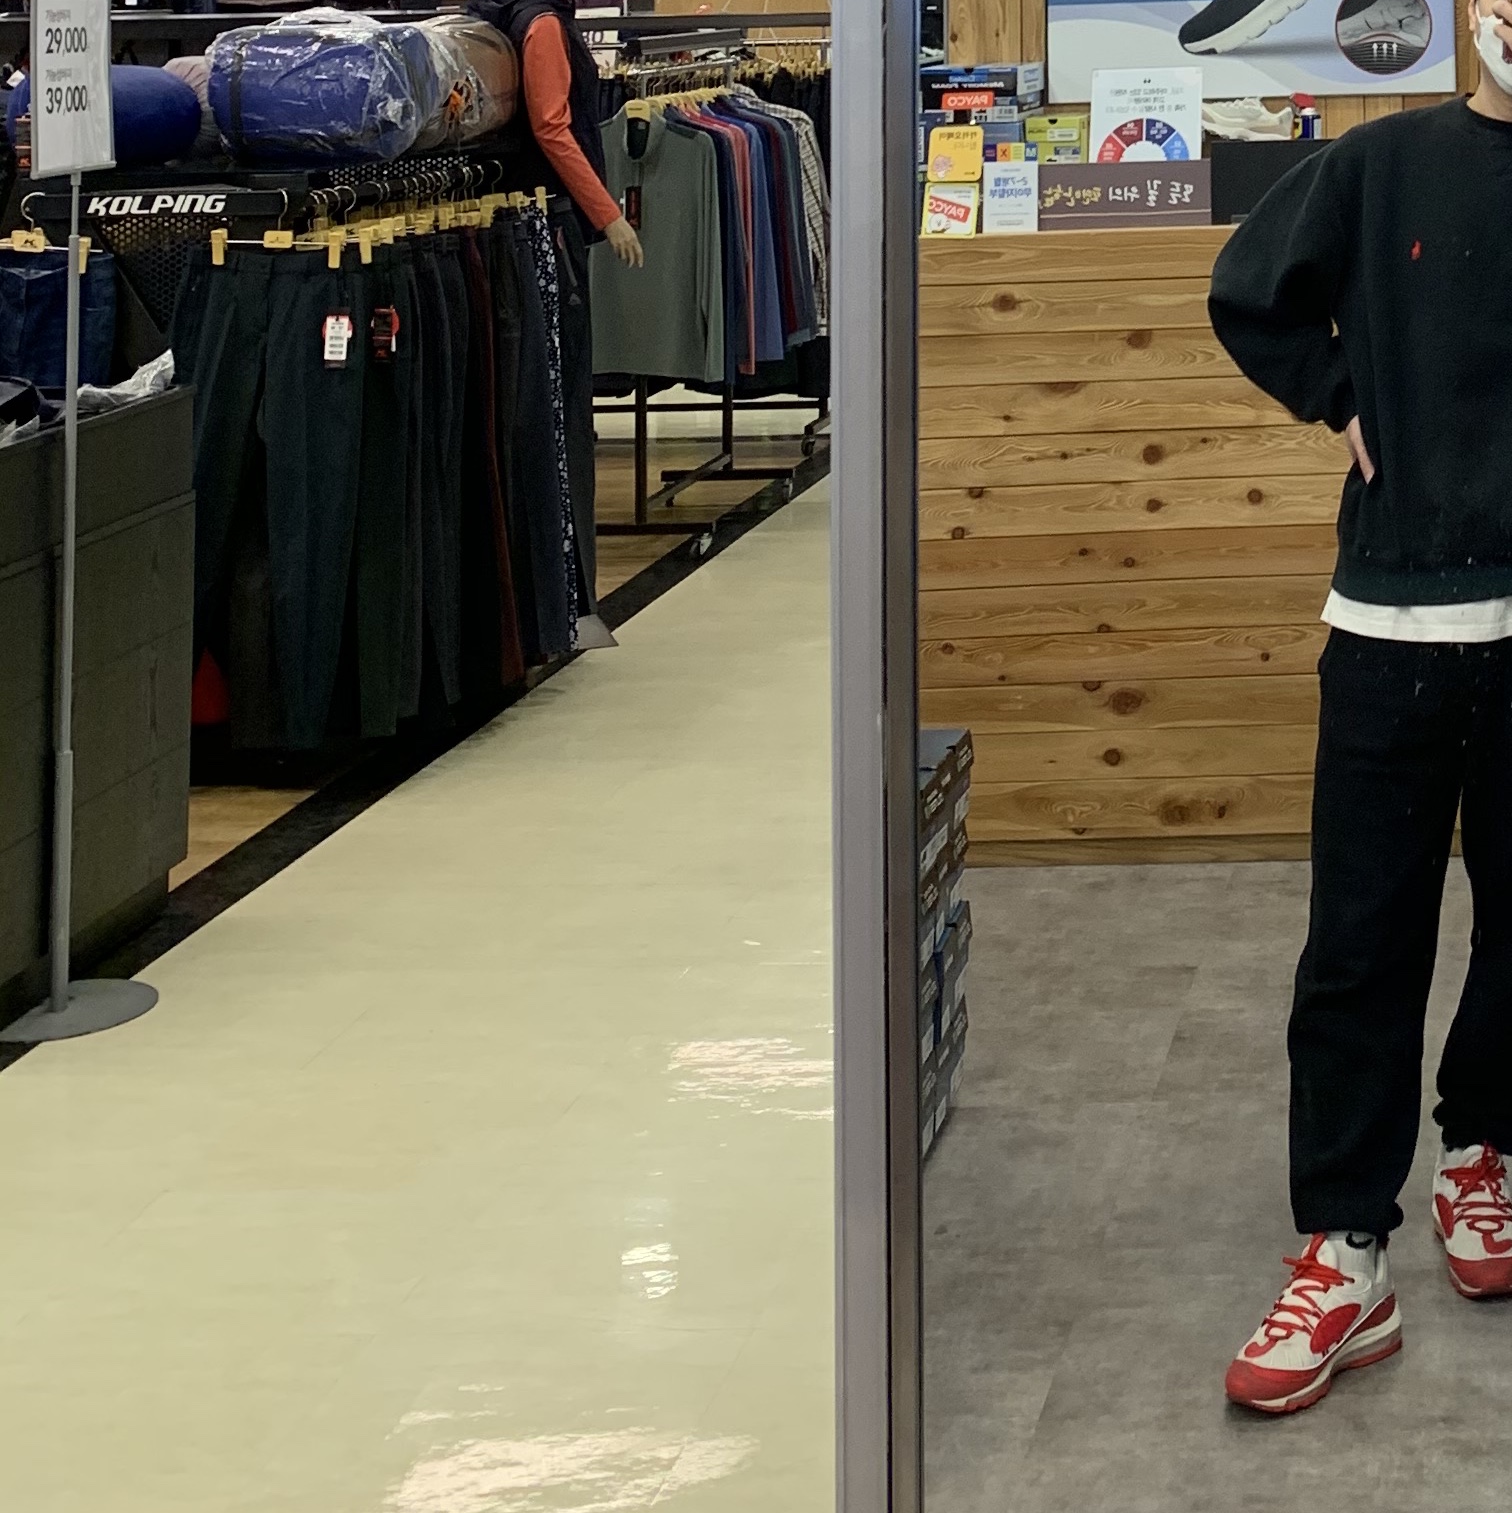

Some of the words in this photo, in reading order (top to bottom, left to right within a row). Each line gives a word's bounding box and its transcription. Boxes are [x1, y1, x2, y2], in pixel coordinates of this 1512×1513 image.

[45, 27, 87, 57] 29,000
[45, 85, 87, 116] 39,000
[87, 194, 226, 216] KOLPING
